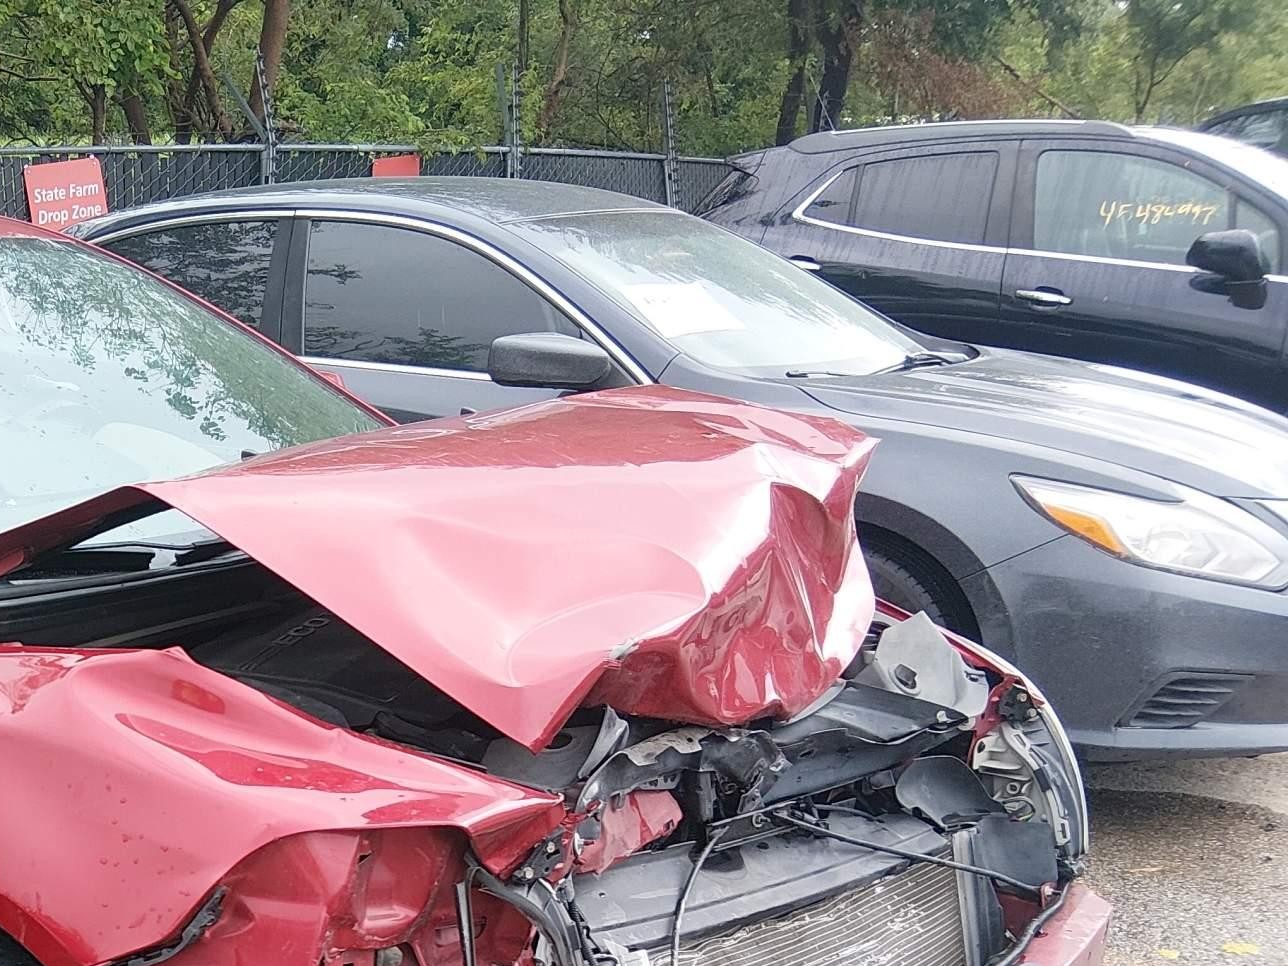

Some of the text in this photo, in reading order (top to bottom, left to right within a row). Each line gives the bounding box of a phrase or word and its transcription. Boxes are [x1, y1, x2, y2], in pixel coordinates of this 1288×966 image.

[34, 183, 99, 203] State Farm
[38, 205, 102, 225] Drop Zone
